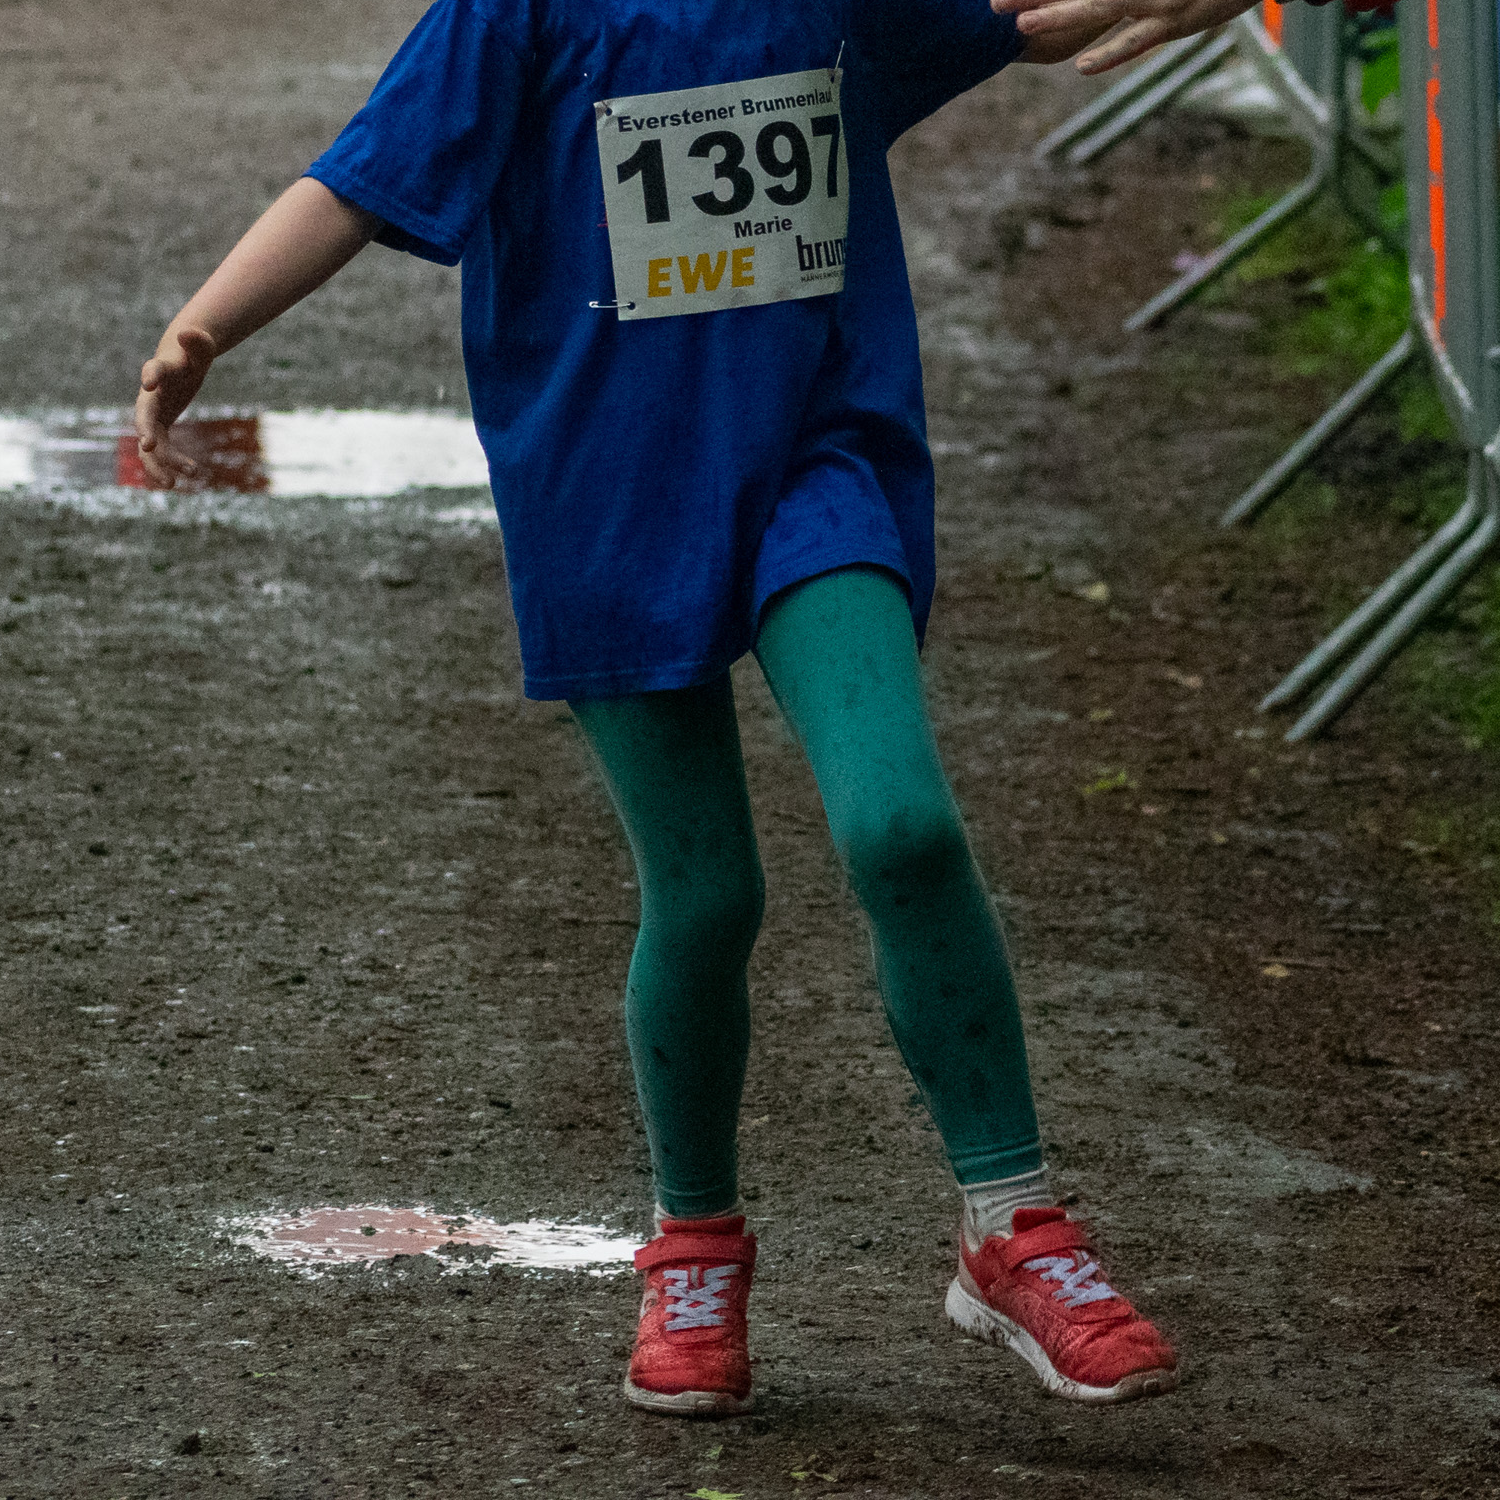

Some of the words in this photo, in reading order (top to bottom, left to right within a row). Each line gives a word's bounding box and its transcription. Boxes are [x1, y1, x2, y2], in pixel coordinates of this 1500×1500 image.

[617, 105, 736, 133] Everstener
[741, 86, 834, 116] Brunnenlau
[616, 113, 840, 224] 1397
[734, 216, 793, 239] Marie
[647, 246, 756, 298] EWE
